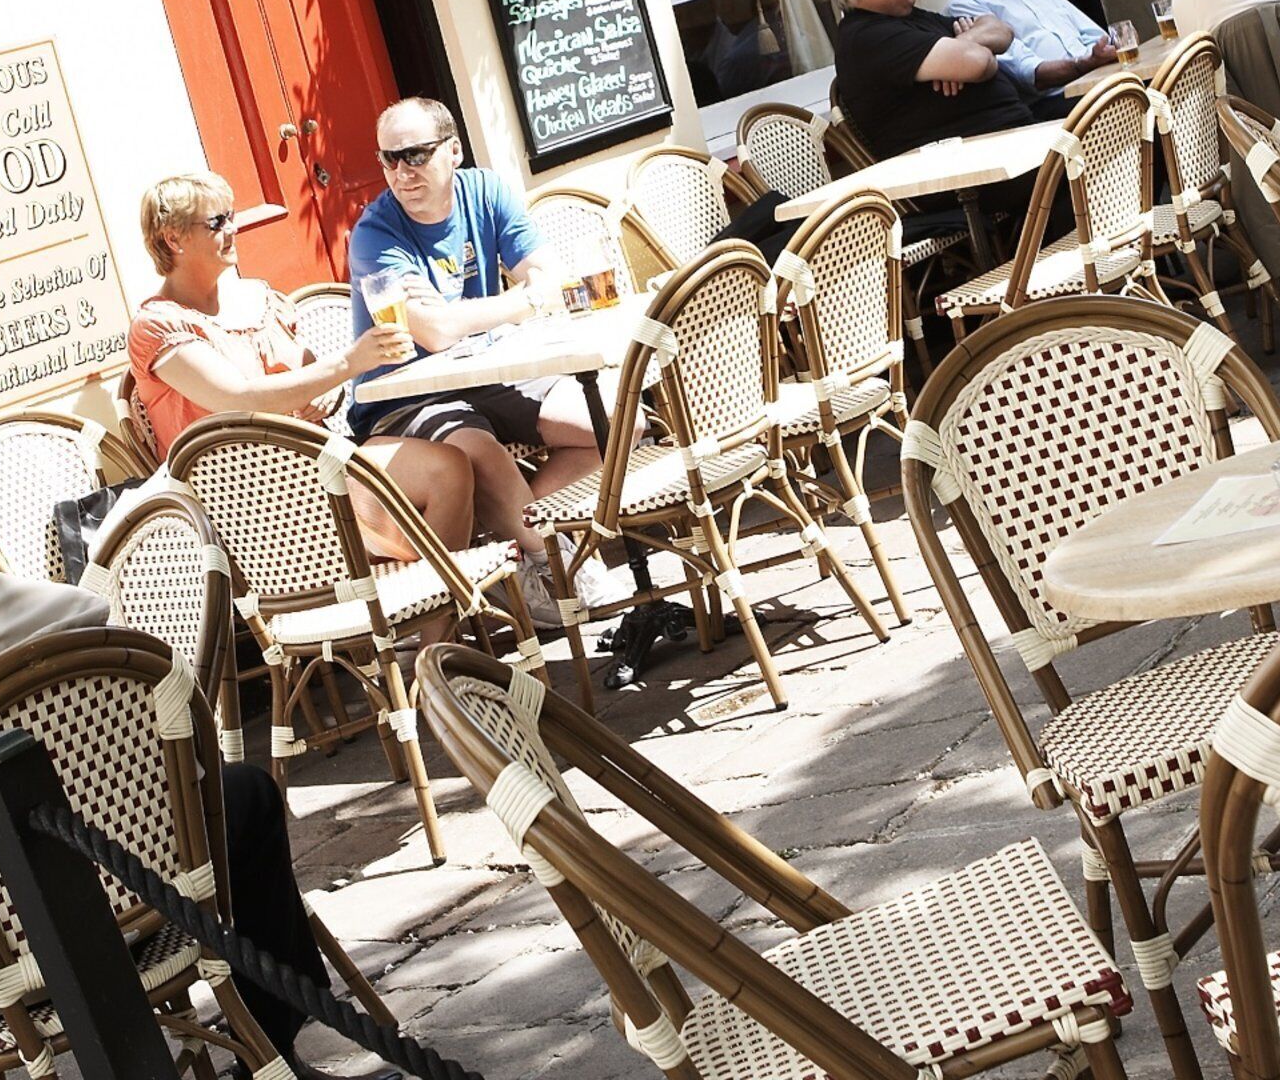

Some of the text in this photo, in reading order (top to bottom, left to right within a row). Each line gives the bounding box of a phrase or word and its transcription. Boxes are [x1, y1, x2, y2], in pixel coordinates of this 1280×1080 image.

[1, 99, 53, 138] Cold
[24, 190, 86, 231] Daily
[10, 264, 84, 305] Selection
[86, 252, 108, 281] Of
[77, 296, 98, 329] &
[72, 331, 128, 366] Lagers
